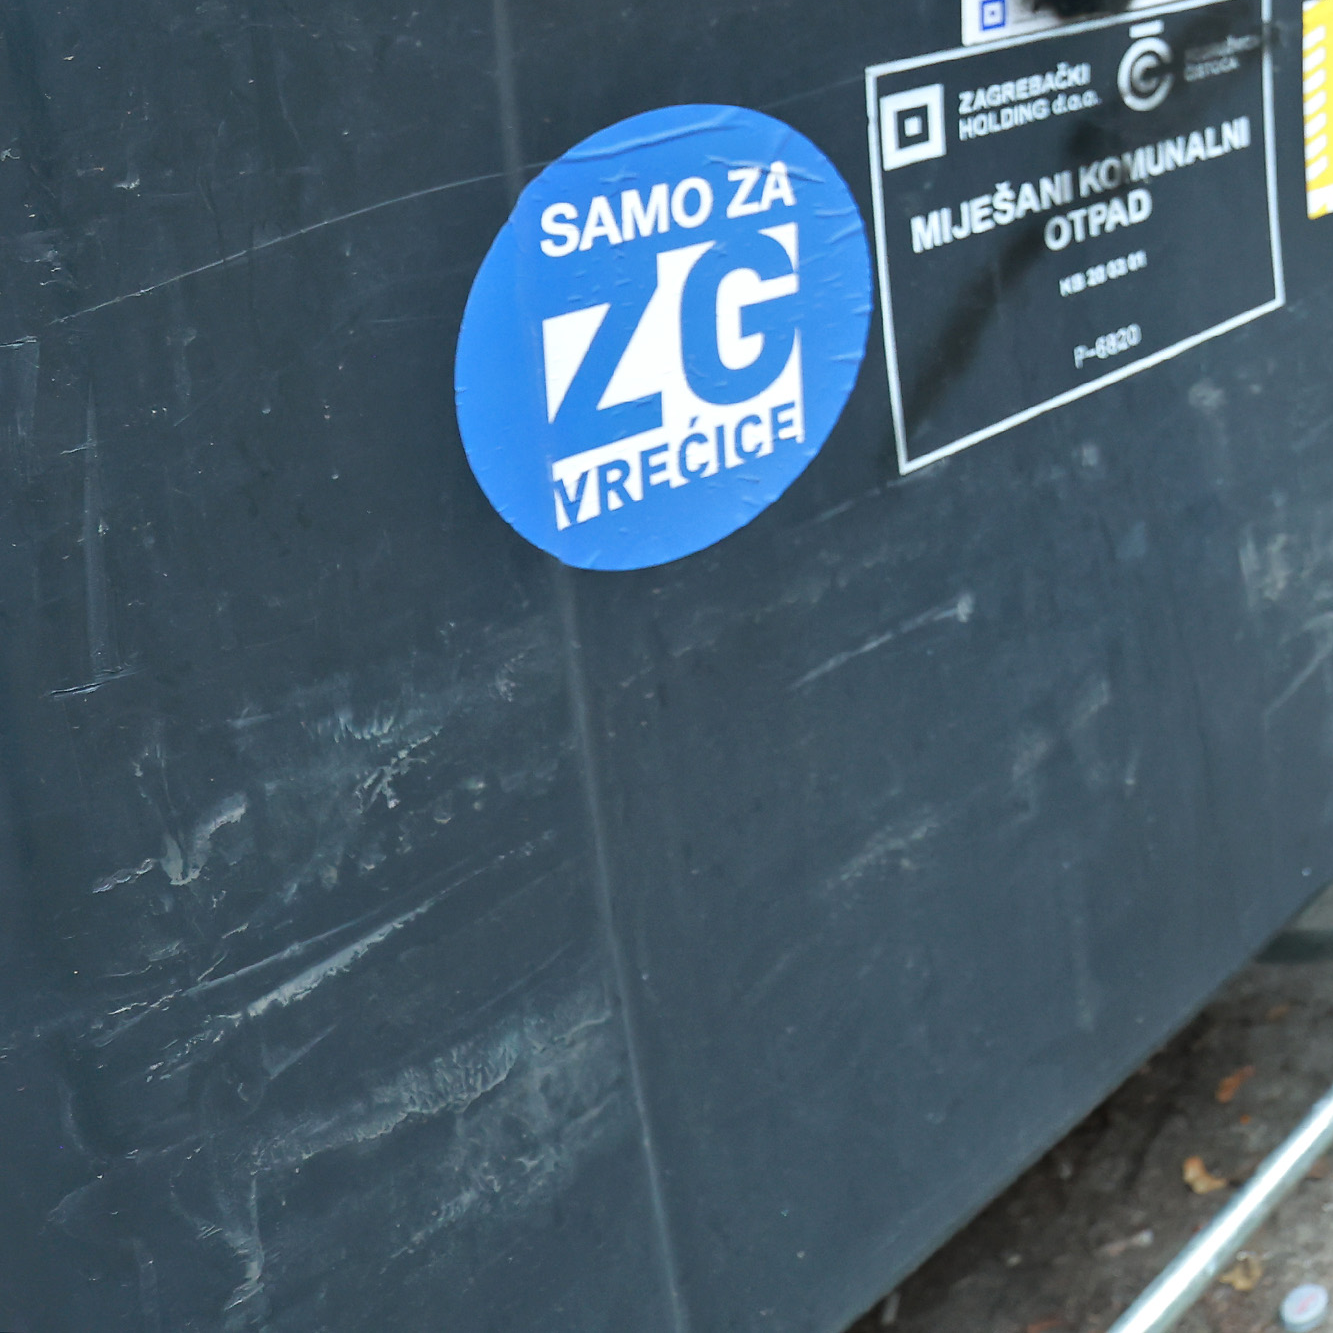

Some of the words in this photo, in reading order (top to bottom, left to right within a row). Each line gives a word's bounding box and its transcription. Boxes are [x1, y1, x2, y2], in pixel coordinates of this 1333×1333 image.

[958, 62, 1092, 115] ZAGREBAČKI
[958, 100, 1050, 142] HOLDING
[540, 176, 714, 258] SAMO
[726, 161, 797, 219] ZA
[910, 169, 1074, 254] MIJEŠANI
[1079, 115, 1252, 199] KOMUNALNI
[1043, 187, 1153, 252] OTPAD
[540, 229, 798, 464] ZG
[552, 399, 800, 528] VREĆICE
